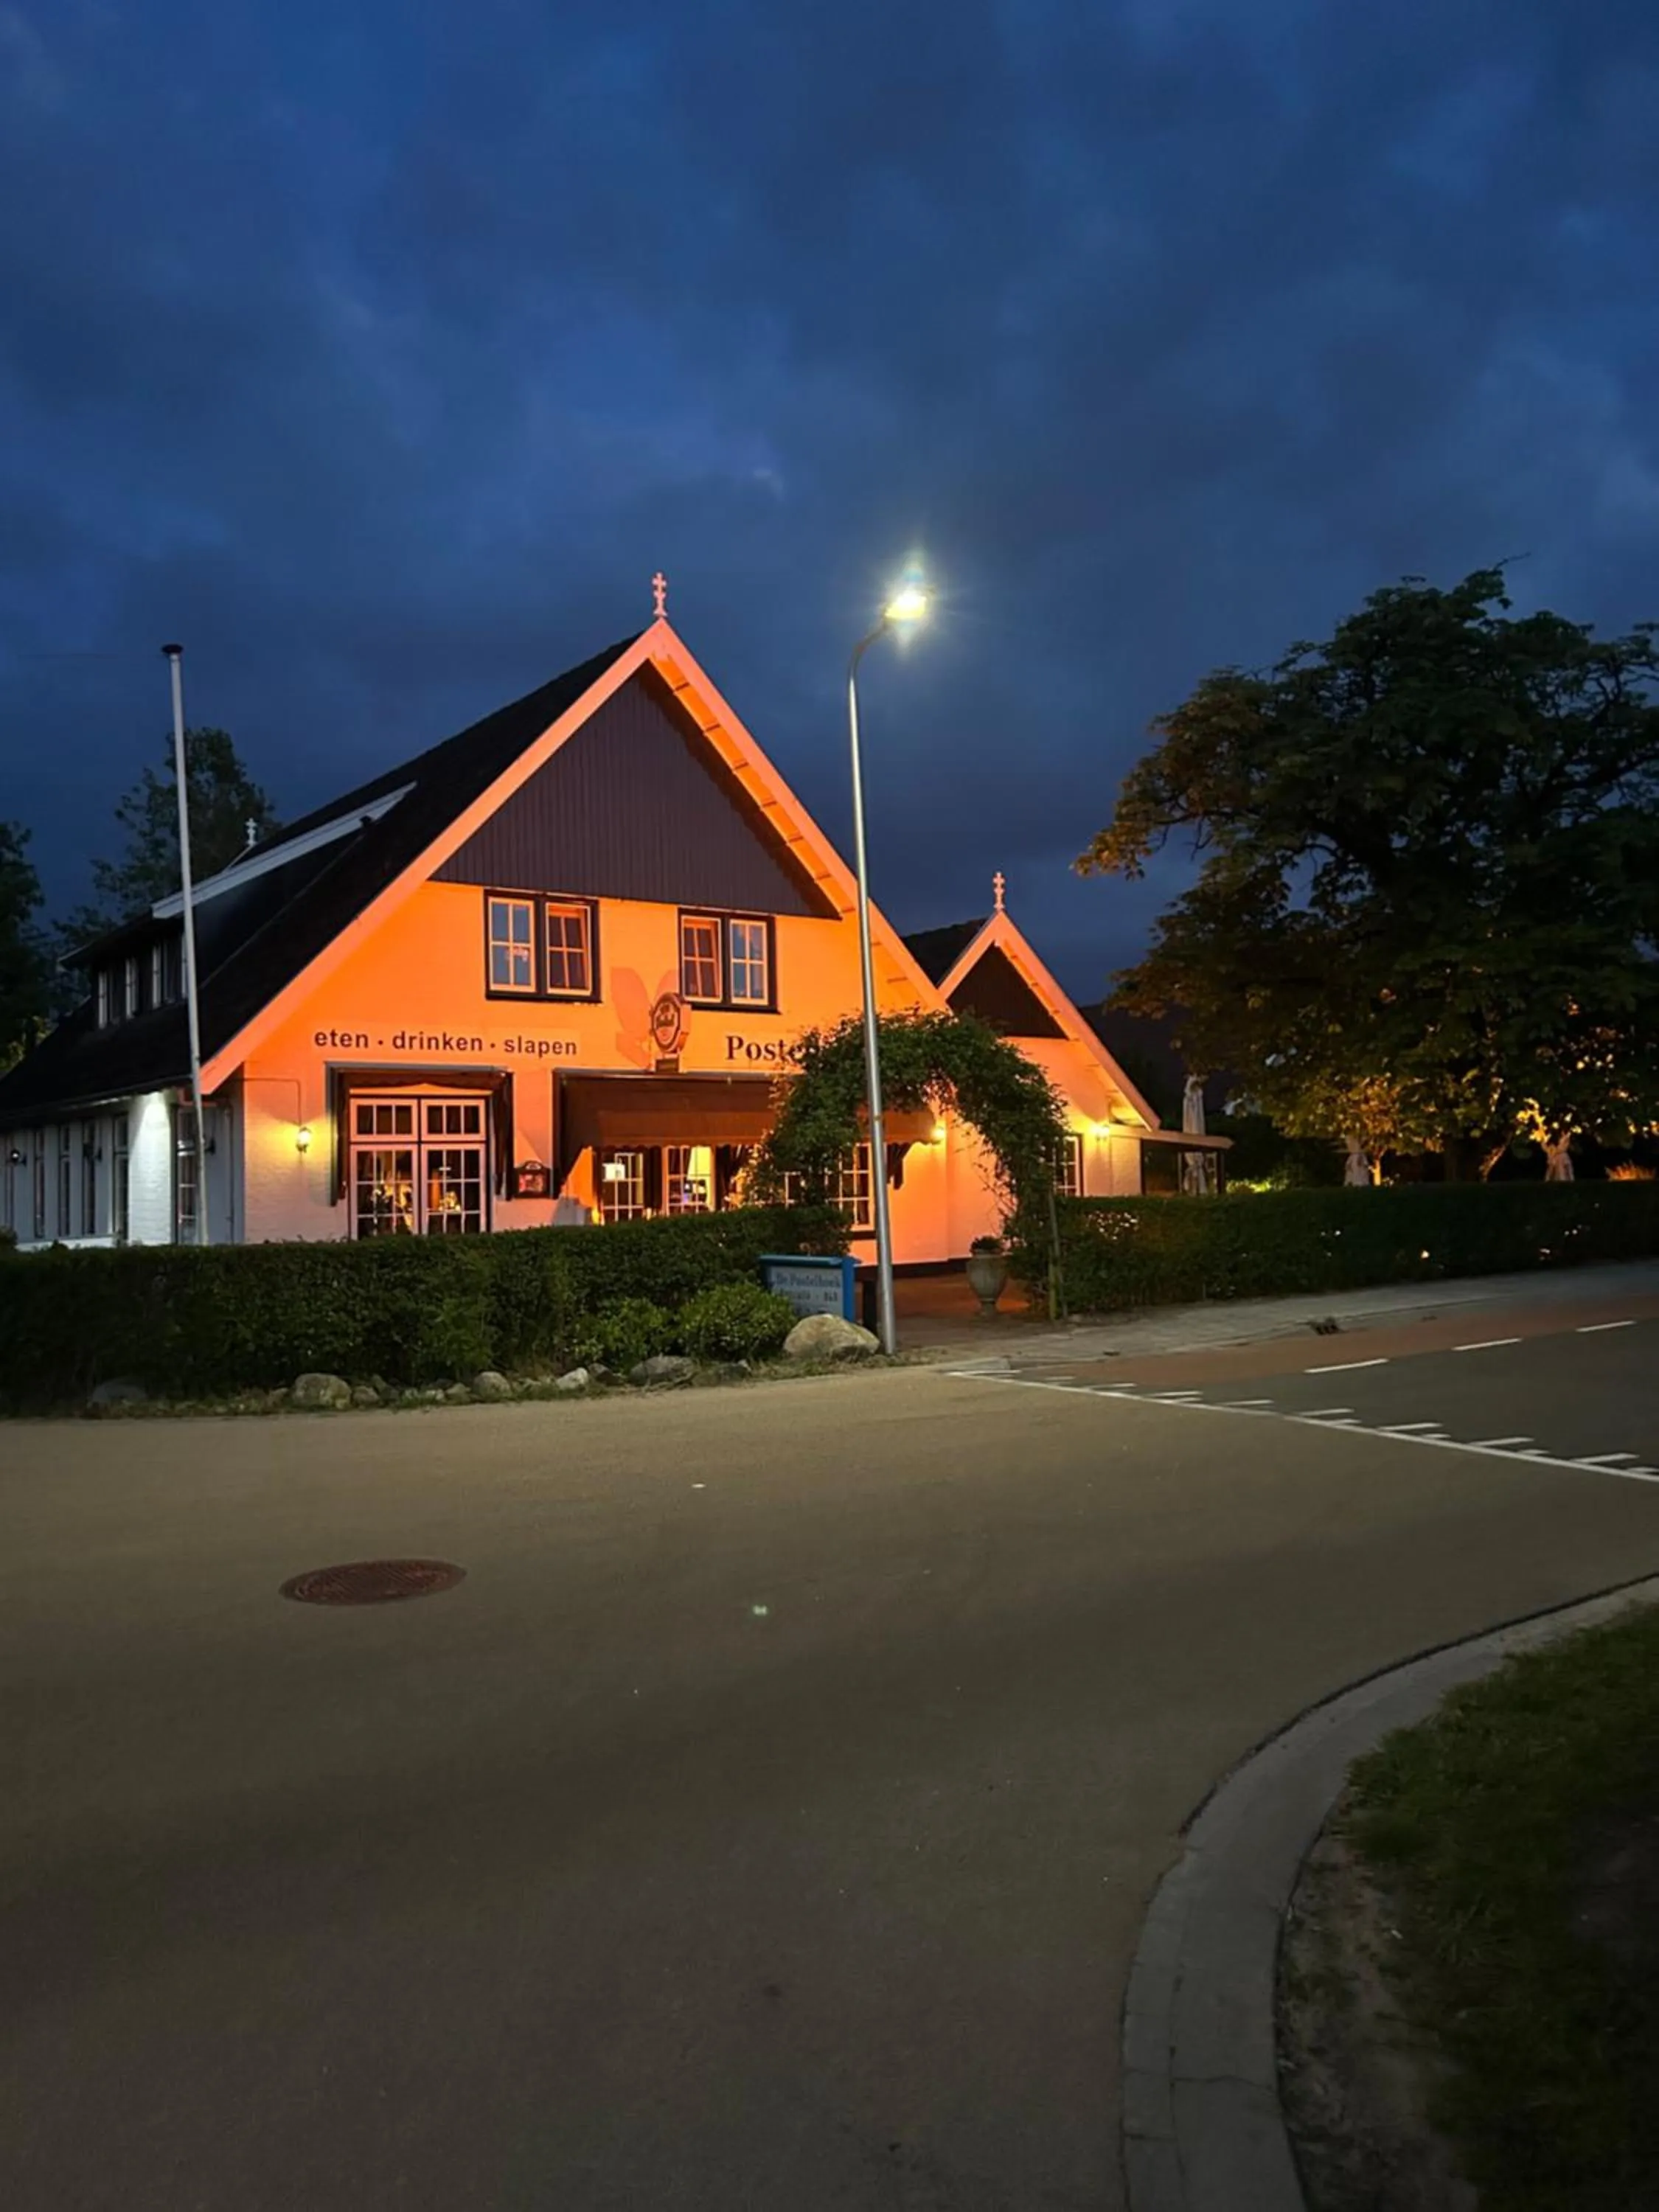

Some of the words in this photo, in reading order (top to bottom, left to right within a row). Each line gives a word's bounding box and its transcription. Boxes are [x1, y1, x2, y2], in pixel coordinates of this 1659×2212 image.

[314, 1029, 369, 1048] eten
[392, 1031, 483, 1051] drinken
[504, 1035, 577, 1059] slapen
[726, 1034, 809, 1063] Poste
